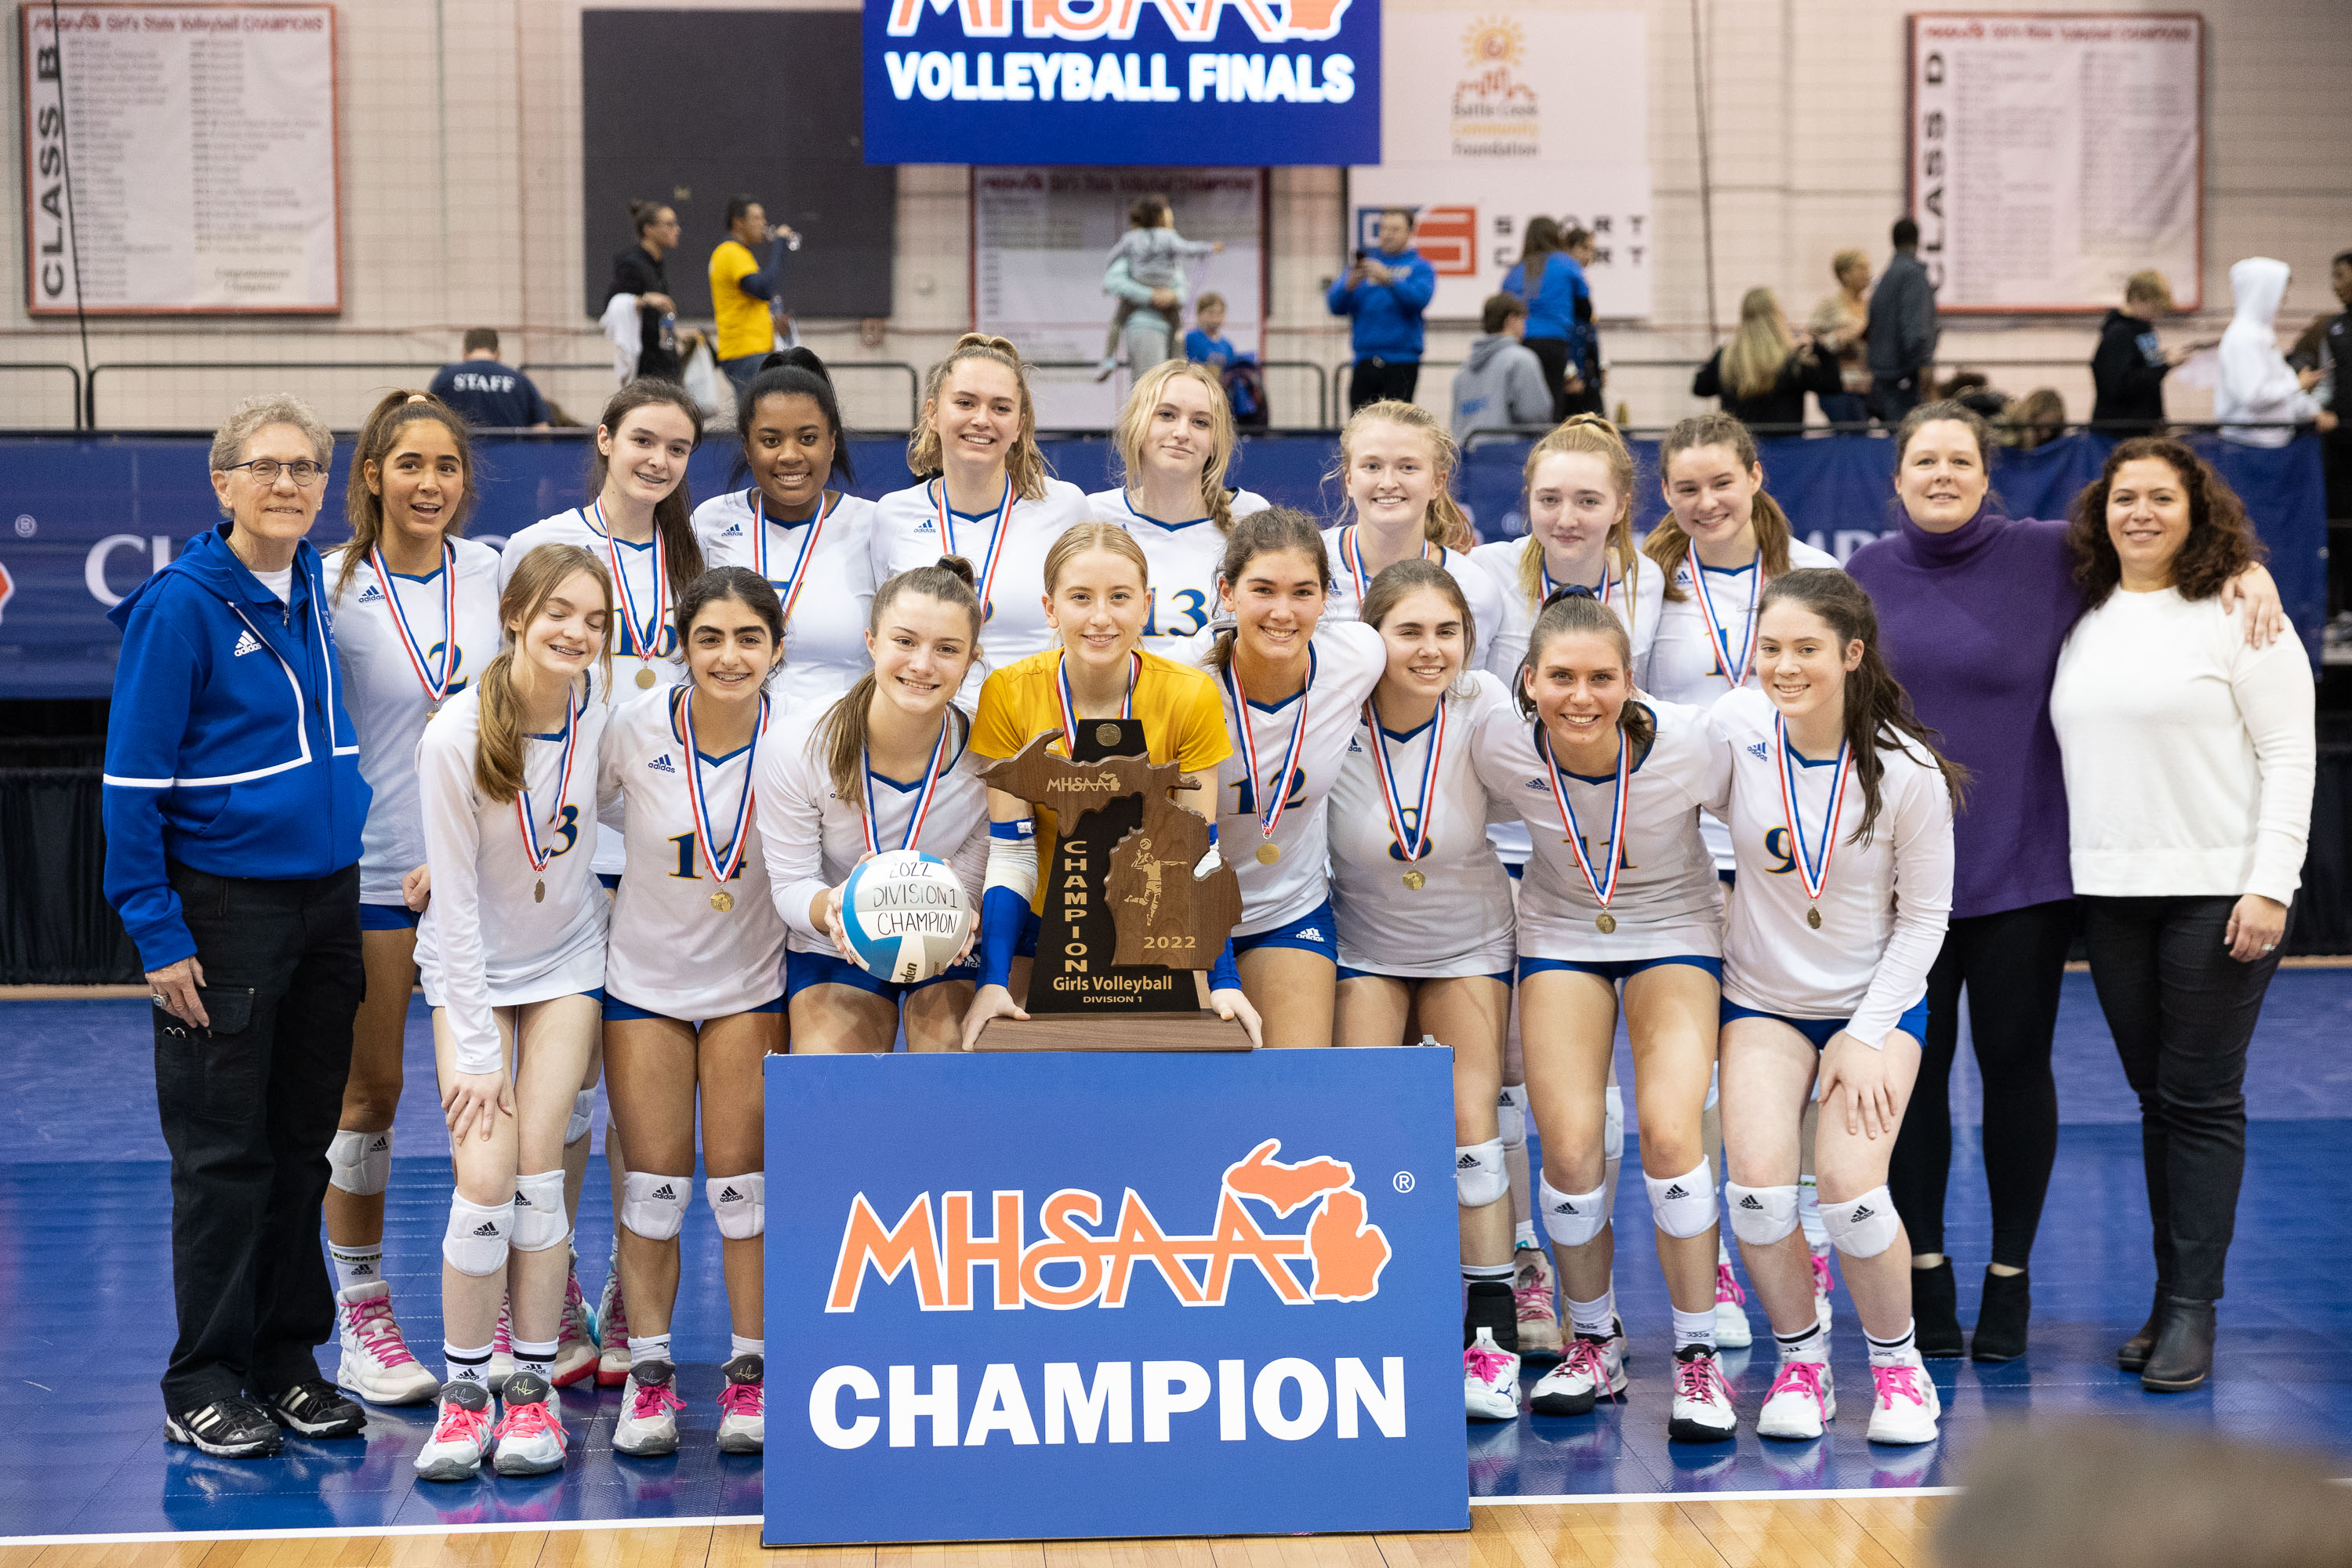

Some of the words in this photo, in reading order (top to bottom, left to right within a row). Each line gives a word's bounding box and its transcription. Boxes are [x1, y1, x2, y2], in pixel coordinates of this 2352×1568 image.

[884, 51, 1180, 102] VOLLEYBALL
[1189, 53, 1356, 103] FINALS
[38, 107, 65, 297] CLASS
[1495, 215, 1645, 234] SORT
[1495, 247, 1645, 267] CRT
[454, 373, 516, 392] STAFF
[358, 593, 386, 603] adidas
[1140, 586, 1210, 638] 13
[612, 607, 681, 659] 16
[234, 641, 263, 657] adidas
[426, 641, 470, 696] 2
[1747, 746, 1768, 762] adidas
[648, 761, 676, 773] adidas
[1046, 777, 1110, 792] MHSAA
[1227, 764, 1309, 815] 12
[1525, 782, 1550, 792] adidas
[541, 803, 579, 858] 3
[667, 830, 748, 880] 14
[1764, 826, 1798, 875] 9
[889, 862, 933, 878] 2022
[873, 884, 946, 908] DIVISION
[949, 888, 957, 909] 1
[1063, 840, 1088, 973] CHAMPION
[877, 911, 957, 935] CHAMPION
[1143, 936, 1196, 949] 2022
[1295, 933, 1324, 942] adidas
[1053, 976, 1089, 991] Girls
[1092, 975, 1172, 993] Volleyball
[1457, 1160, 1481, 1169] adidas
[652, 1192, 677, 1200] adidas
[720, 1193, 743, 1203] adidas
[1664, 1191, 1690, 1200] adidas
[1850, 1210, 1875, 1223] adidas
[825, 1188, 1314, 1313] MHSAA
[808, 1357, 1406, 1450] CHAMPION
